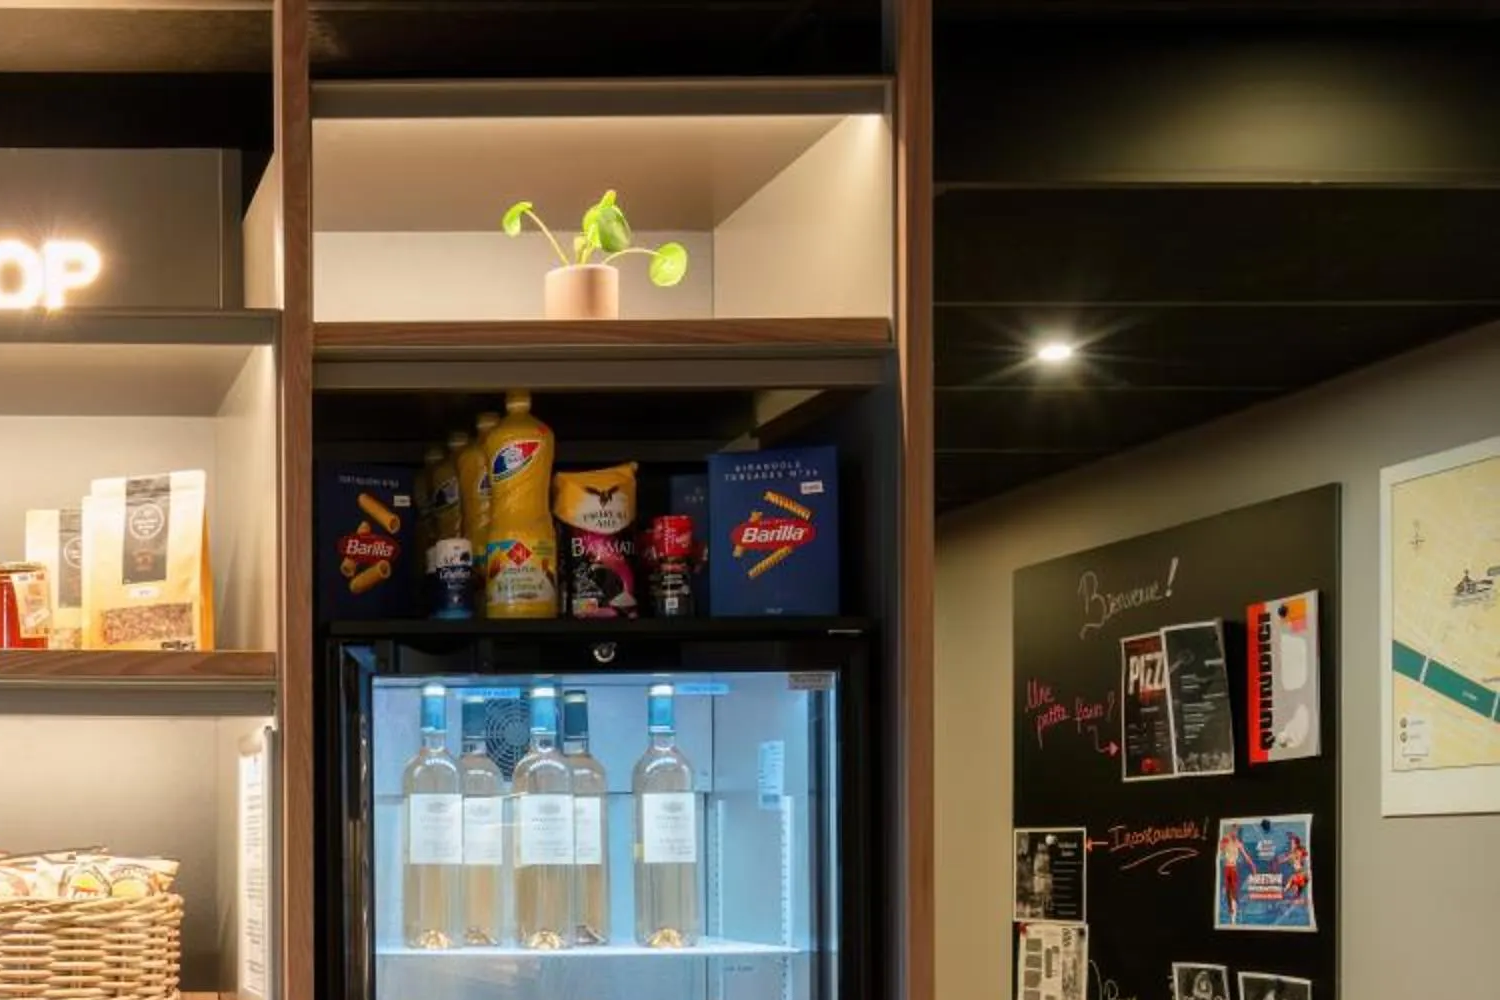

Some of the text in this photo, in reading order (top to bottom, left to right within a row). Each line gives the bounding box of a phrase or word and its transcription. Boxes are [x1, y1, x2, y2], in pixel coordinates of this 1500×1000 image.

[741, 524, 807, 543] Barilla
[345, 538, 395, 558] Barilla
[1127, 651, 1167, 696] PIZZ
